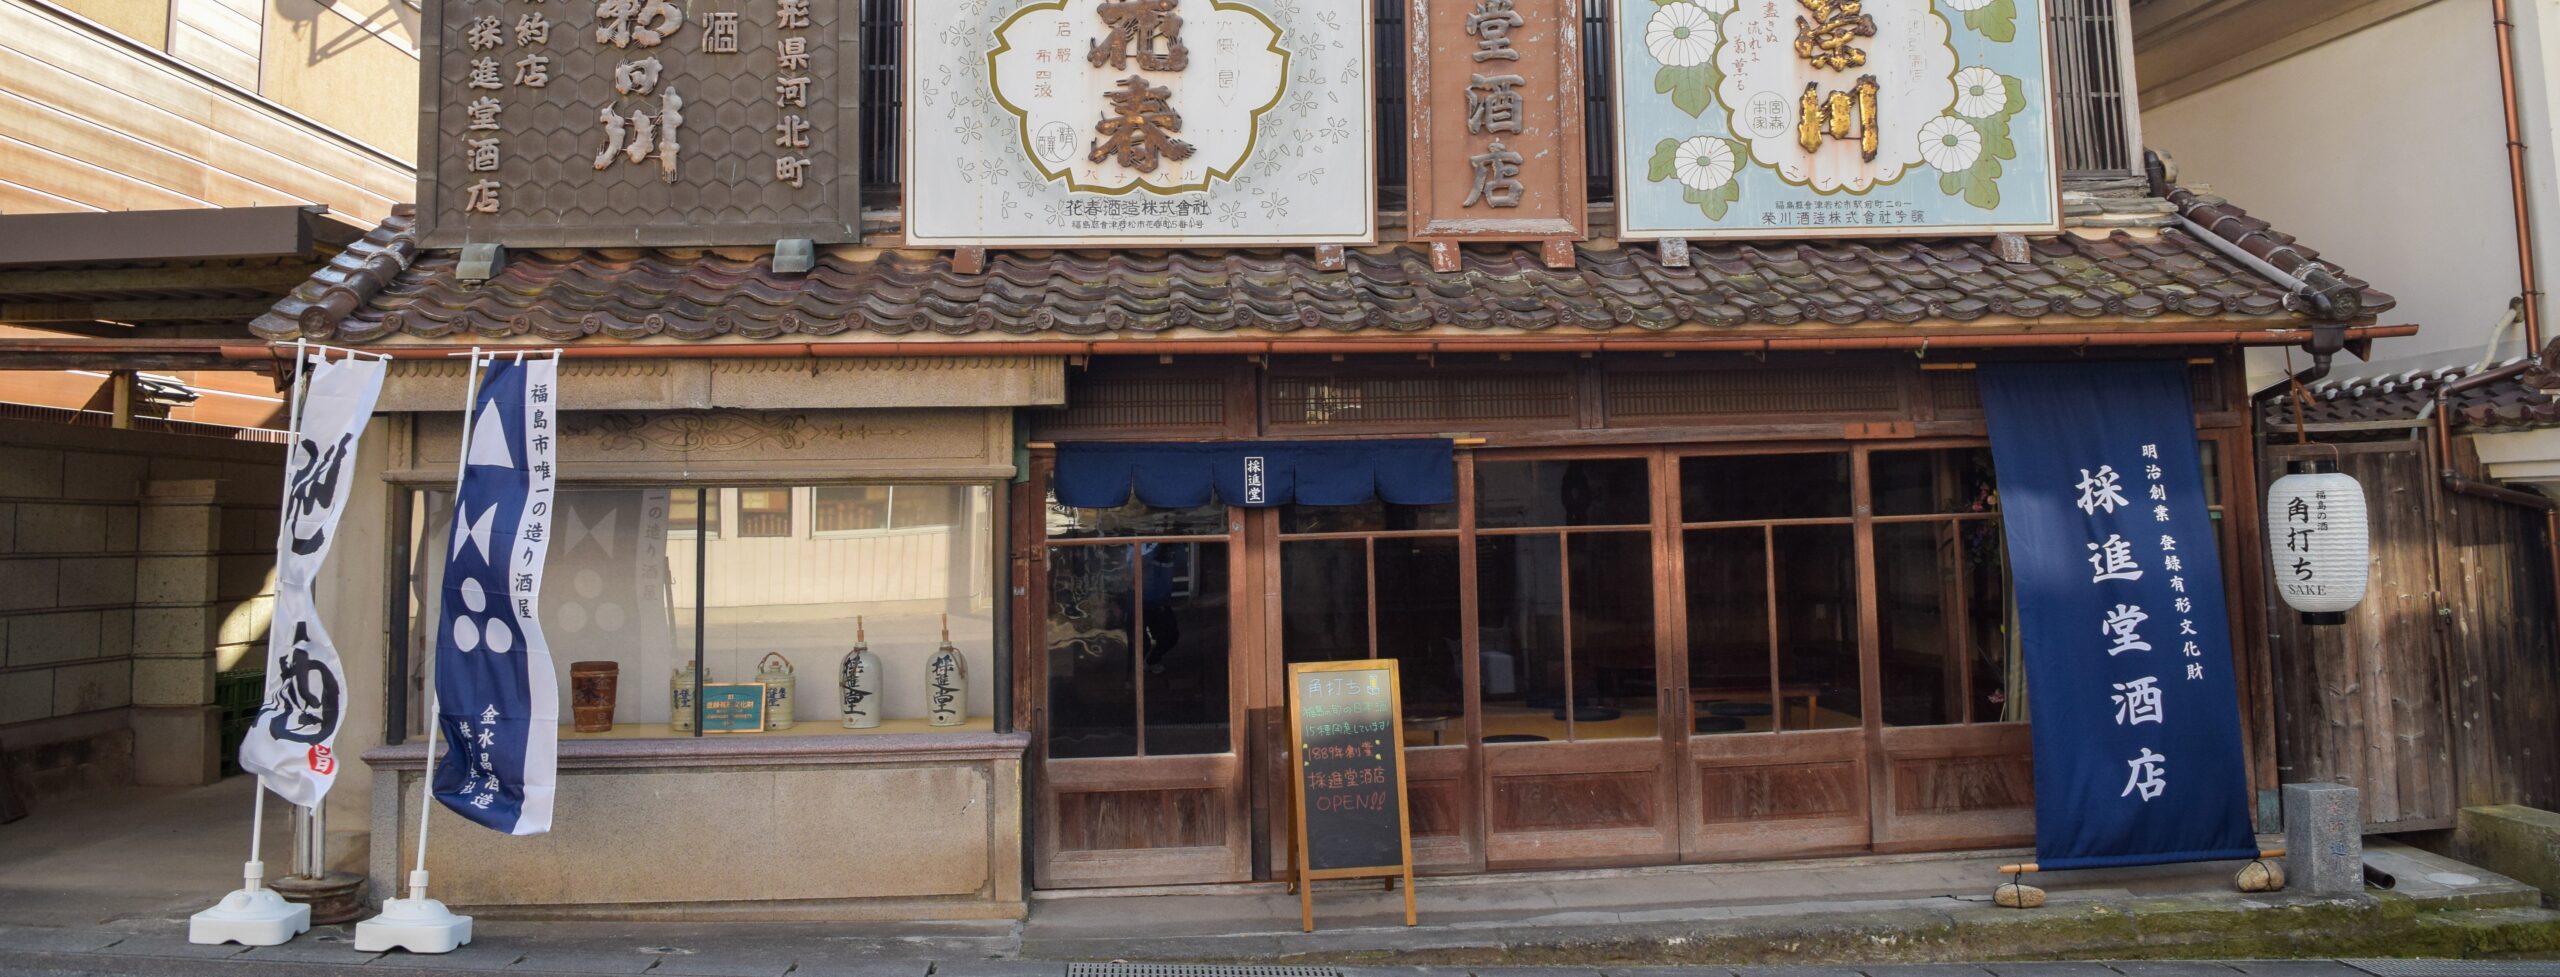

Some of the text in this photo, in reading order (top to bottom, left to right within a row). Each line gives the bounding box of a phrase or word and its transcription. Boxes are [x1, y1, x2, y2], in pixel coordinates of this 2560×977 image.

[702, 12, 739, 54] 酒
[465, 14, 504, 213] 採進堂酒店
[514, 384, 550, 619] 福島市唯一の造り酒屋
[1247, 459, 1262, 501] 採進堂
[2315, 490, 2329, 532] 福島の酒
[2142, 443, 2204, 681] 明治創業 登録有形文化財
[2286, 496, 2315, 582] 角打ち
[2287, 584, 2327, 596] SAKE
[2075, 465, 2167, 802] 採進堂酒店
[1308, 678, 1361, 698] 角打ち
